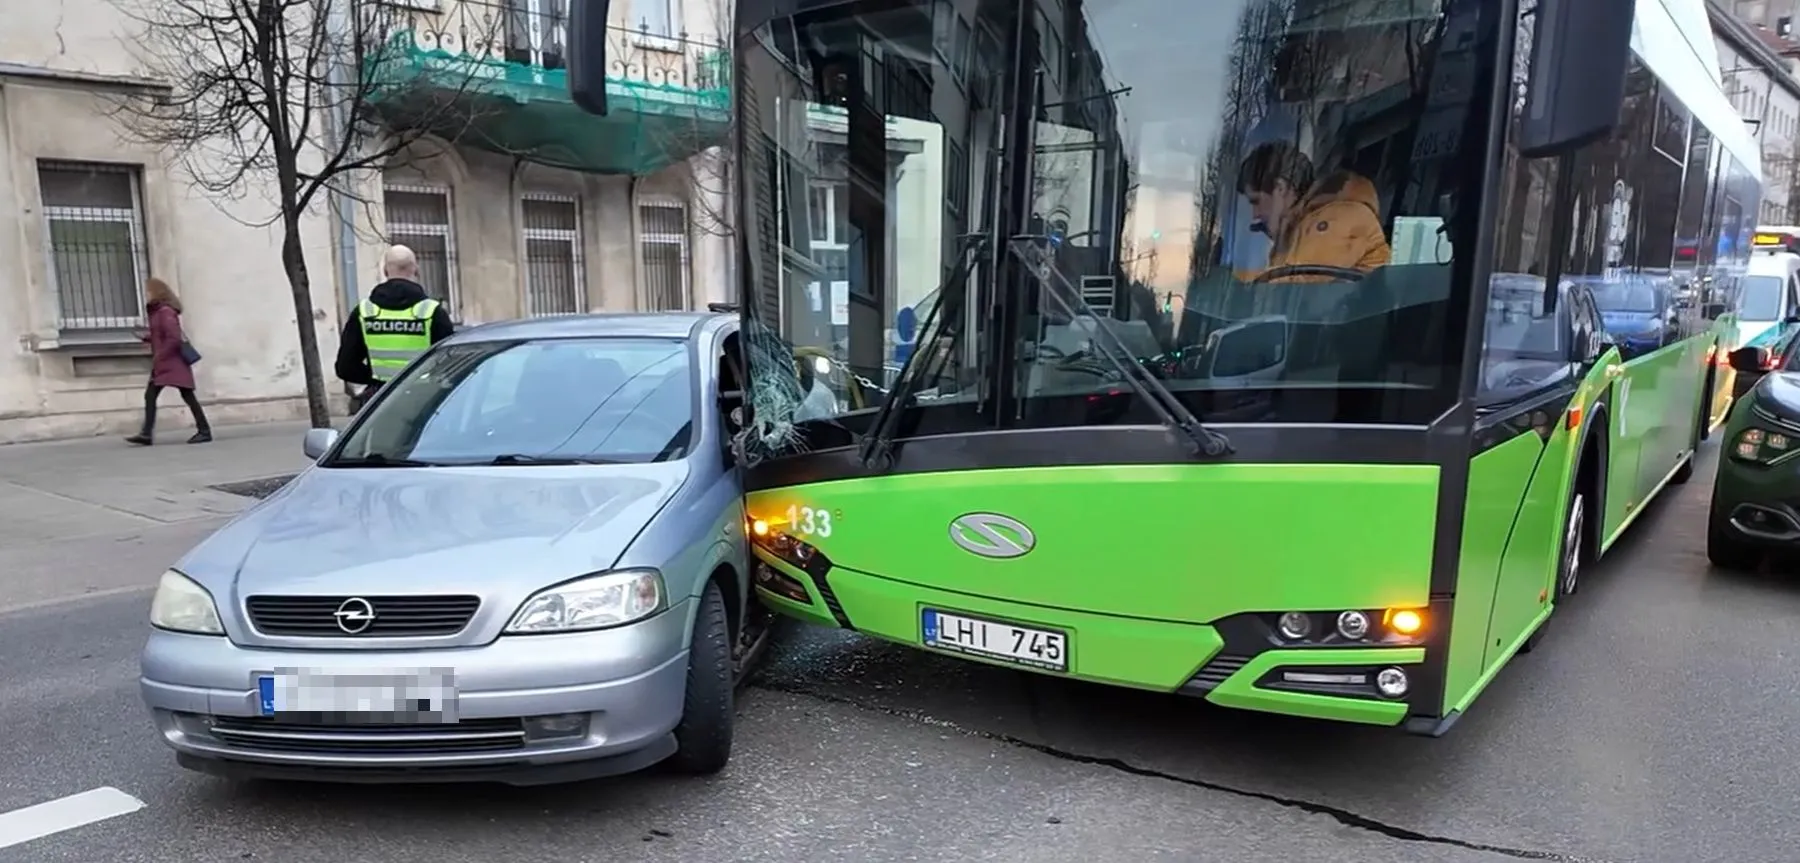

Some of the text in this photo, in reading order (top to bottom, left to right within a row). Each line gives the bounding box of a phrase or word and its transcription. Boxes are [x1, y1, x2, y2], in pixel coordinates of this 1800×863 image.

[365, 320, 424, 332] POLICIJA
[786, 504, 832, 538] 133
[940, 617, 986, 648] LHI
[1011, 629, 1060, 660] 745
